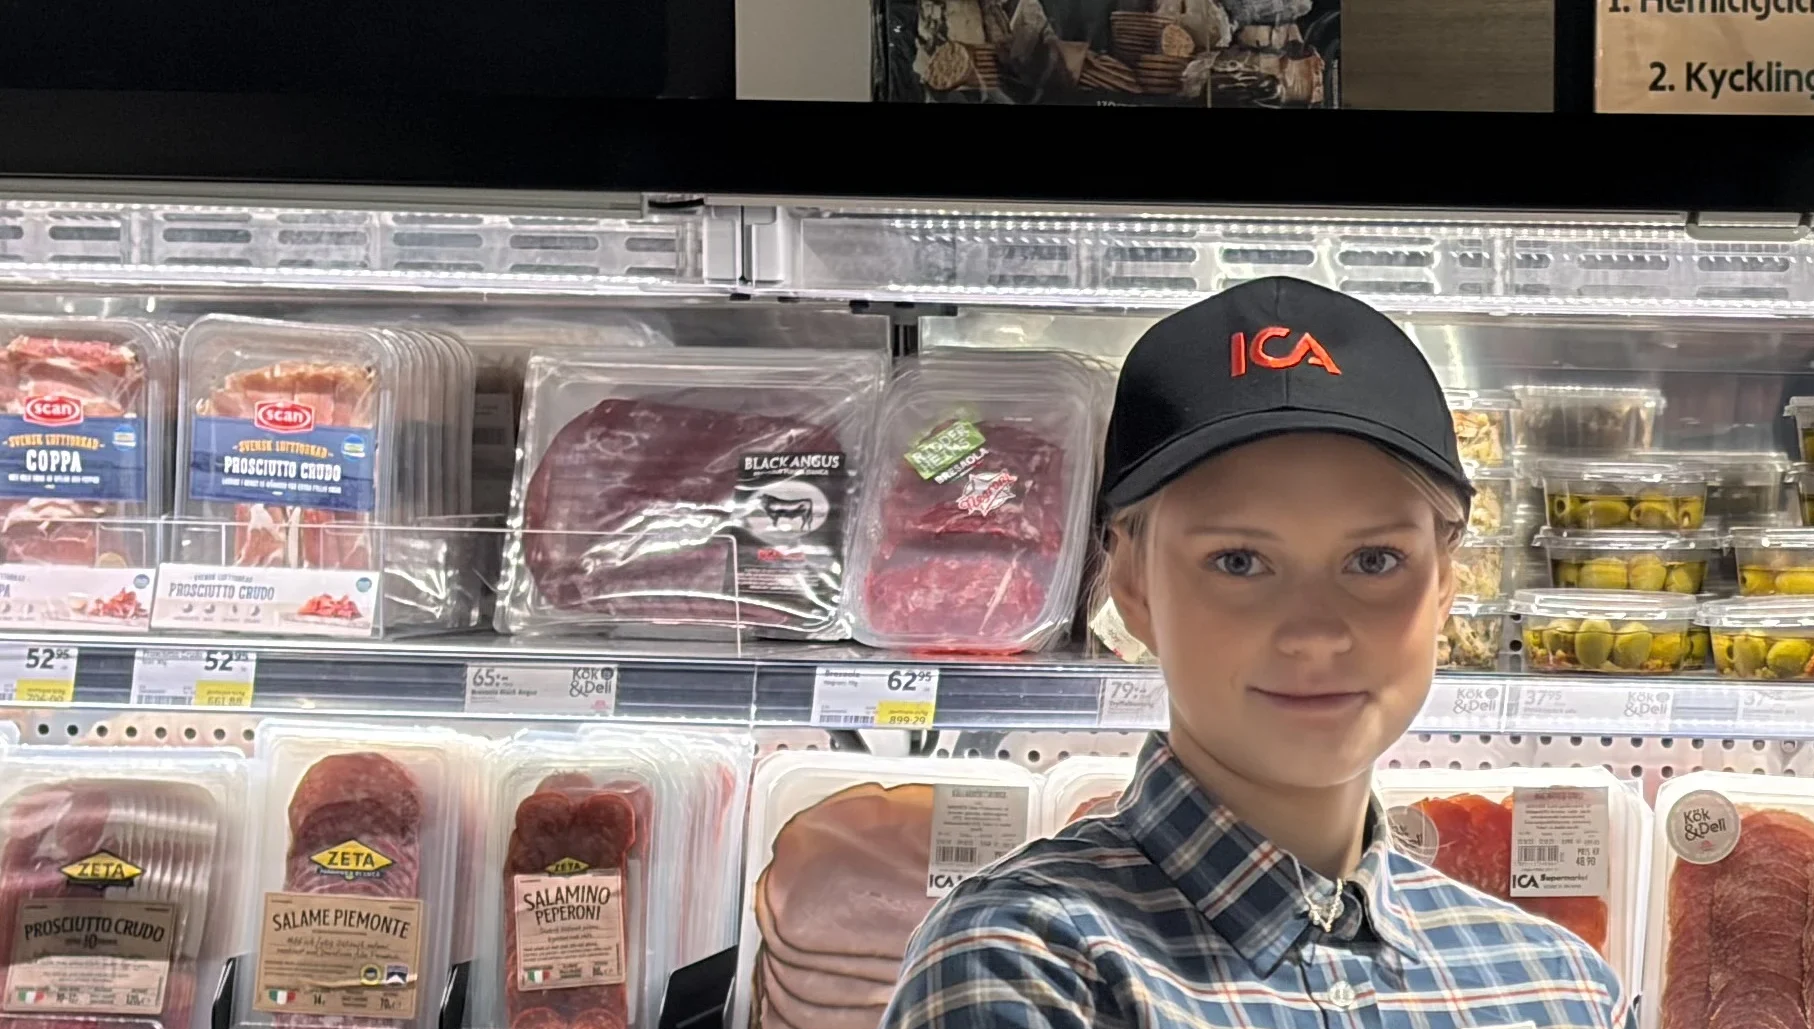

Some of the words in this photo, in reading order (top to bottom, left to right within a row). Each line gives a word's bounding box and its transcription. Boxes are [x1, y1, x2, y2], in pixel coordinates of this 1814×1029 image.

[1649, 62, 1675, 93] 2.
[1231, 326, 1342, 377] ICA
[34, 402, 73, 417] scan
[264, 408, 305, 424] scan
[26, 449, 82, 474] COPPA
[224, 455, 297, 480] PROSCIUTTO
[300, 460, 342, 483] CRUDO
[744, 454, 790, 471] BLACK
[793, 453, 840, 470] ANGUS
[168, 582, 237, 600] PROSCIUTTO
[239, 584, 276, 601] CRUDO
[25, 648, 55, 670] 52
[204, 650, 234, 673] 52
[569, 680, 612, 697] &Deli
[887, 670, 917, 691] 62
[918, 671, 932, 682] 95
[1457, 687, 1483, 700] Kök
[1525, 690, 1545, 706] 37
[1628, 691, 1654, 703] Kök
[1452, 699, 1497, 714] &Deli
[1624, 702, 1668, 717] &Deli
[1683, 807, 1711, 823] Kök
[1684, 819, 1727, 843] &Deli
[327, 851, 375, 868] ZETA
[78, 862, 125, 878] ZETA
[929, 873, 954, 889] ICA
[1512, 874, 1540, 889] ICA
[523, 885, 611, 912] SALAMINO
[272, 909, 330, 932] SALAME
[334, 908, 411, 939] PIEMONTE
[535, 904, 601, 925] PEPERONI
[25, 916, 112, 941] PROSCIUTTO
[114, 917, 165, 942] CRUDO
